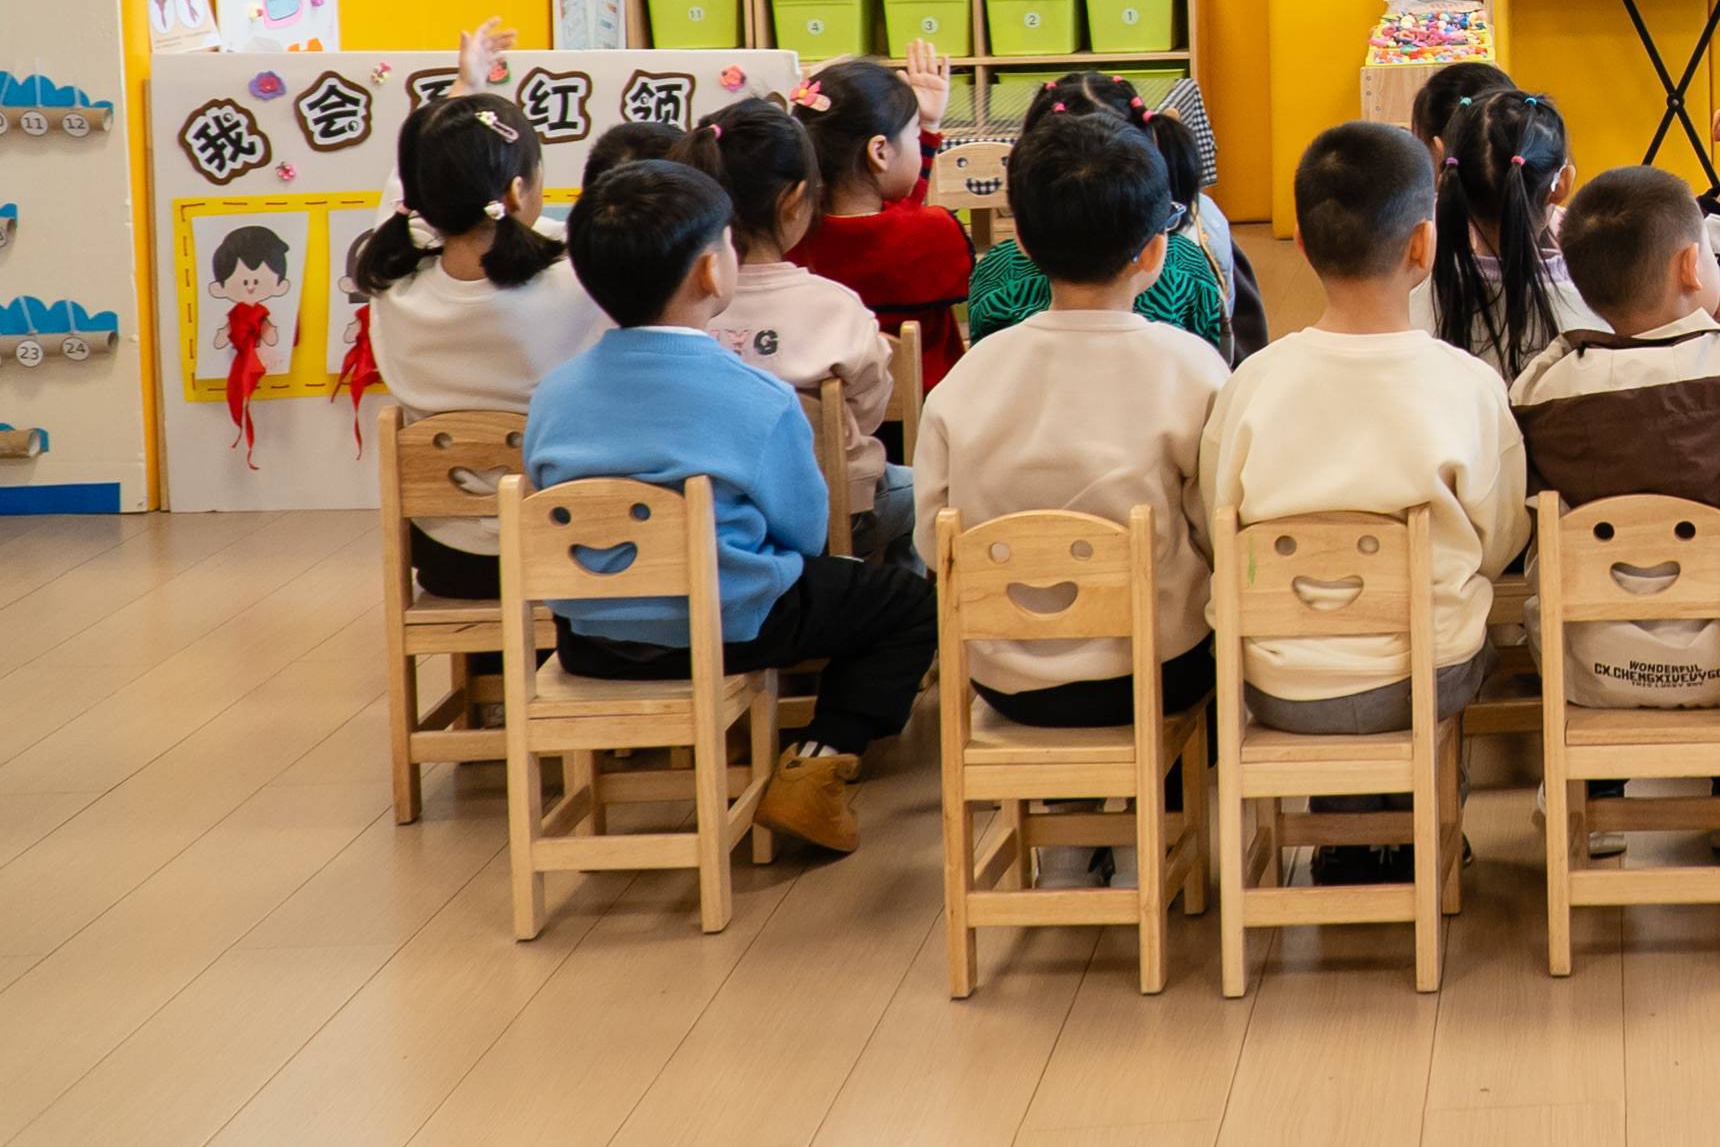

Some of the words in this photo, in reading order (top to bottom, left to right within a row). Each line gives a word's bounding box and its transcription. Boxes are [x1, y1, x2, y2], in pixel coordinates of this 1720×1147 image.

[688, 9, 703, 21] 11
[1028, 14, 1038, 26] 2
[1126, 10, 1134, 22] 1
[810, 20, 821, 32] 4
[925, 19, 935, 31] 3
[24, 117, 43, 130] 11
[66, 118, 86, 130] 12
[20, 346, 40, 360] 23
[66, 342, 86, 354] 24
[1629, 660, 1702, 674] WONDERFUL
